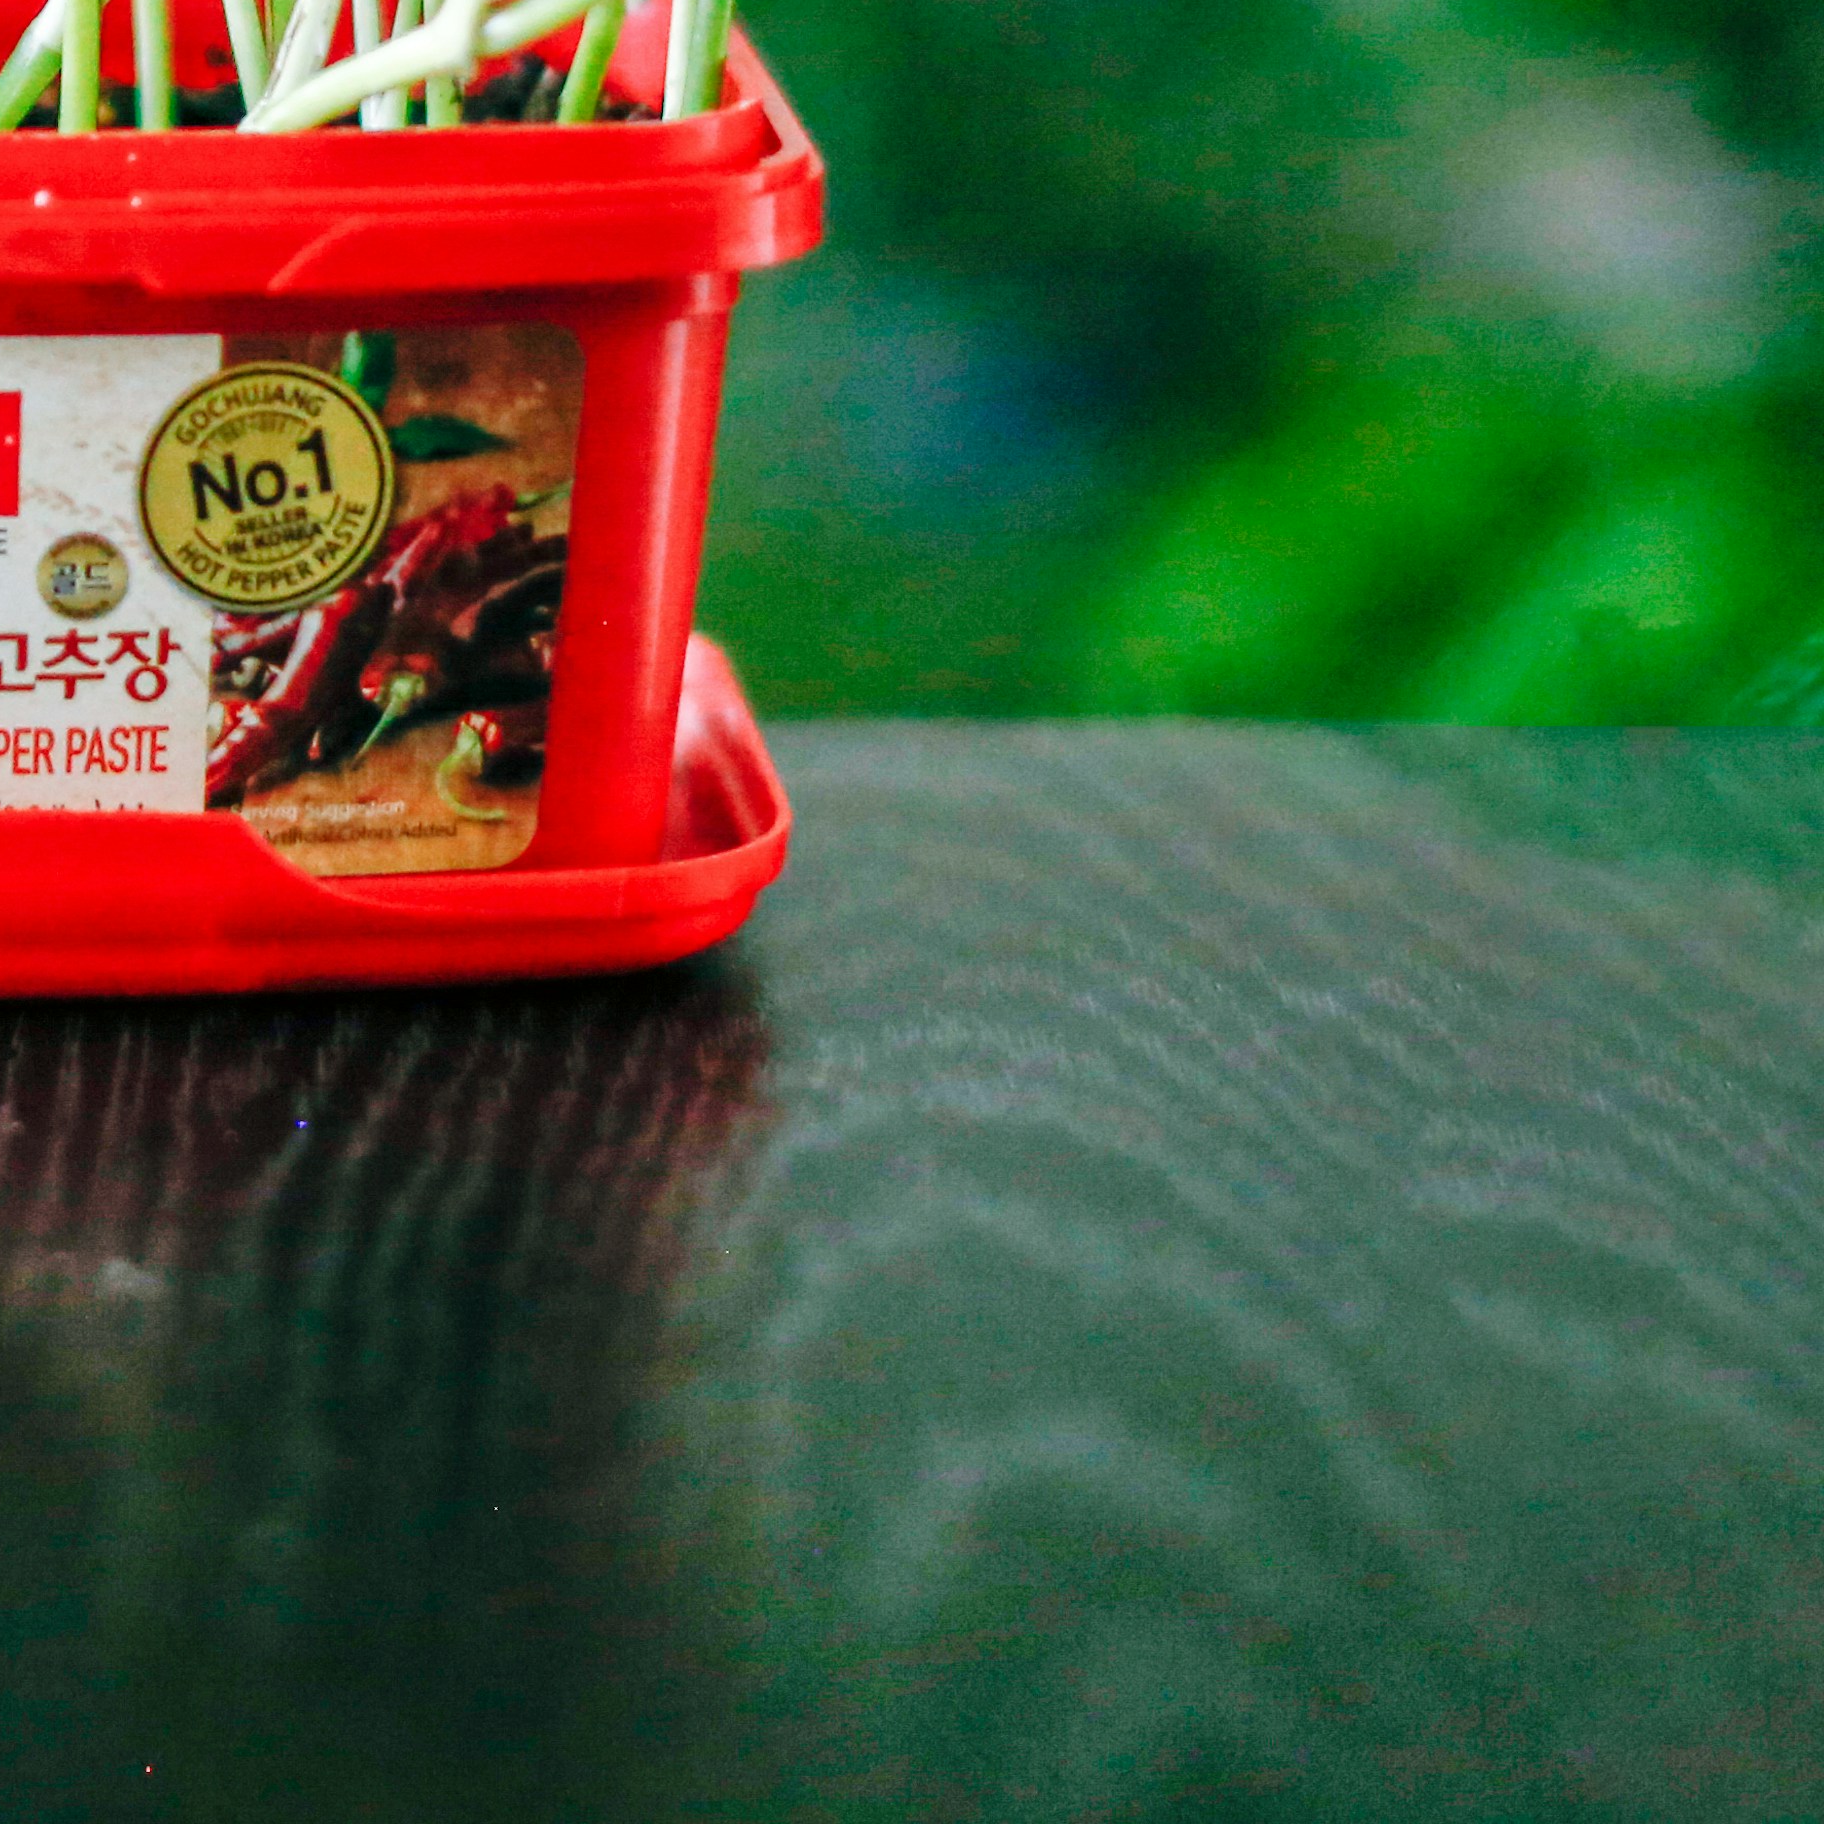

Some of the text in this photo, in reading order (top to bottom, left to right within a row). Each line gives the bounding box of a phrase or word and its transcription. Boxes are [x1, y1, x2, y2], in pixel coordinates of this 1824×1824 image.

[175, 383, 328, 447] GOCHUJANG
[188, 426, 333, 520] No.1
[178, 501, 368, 593] HOT PEPPER PASTE
[65, 725, 169, 773] PASTE
